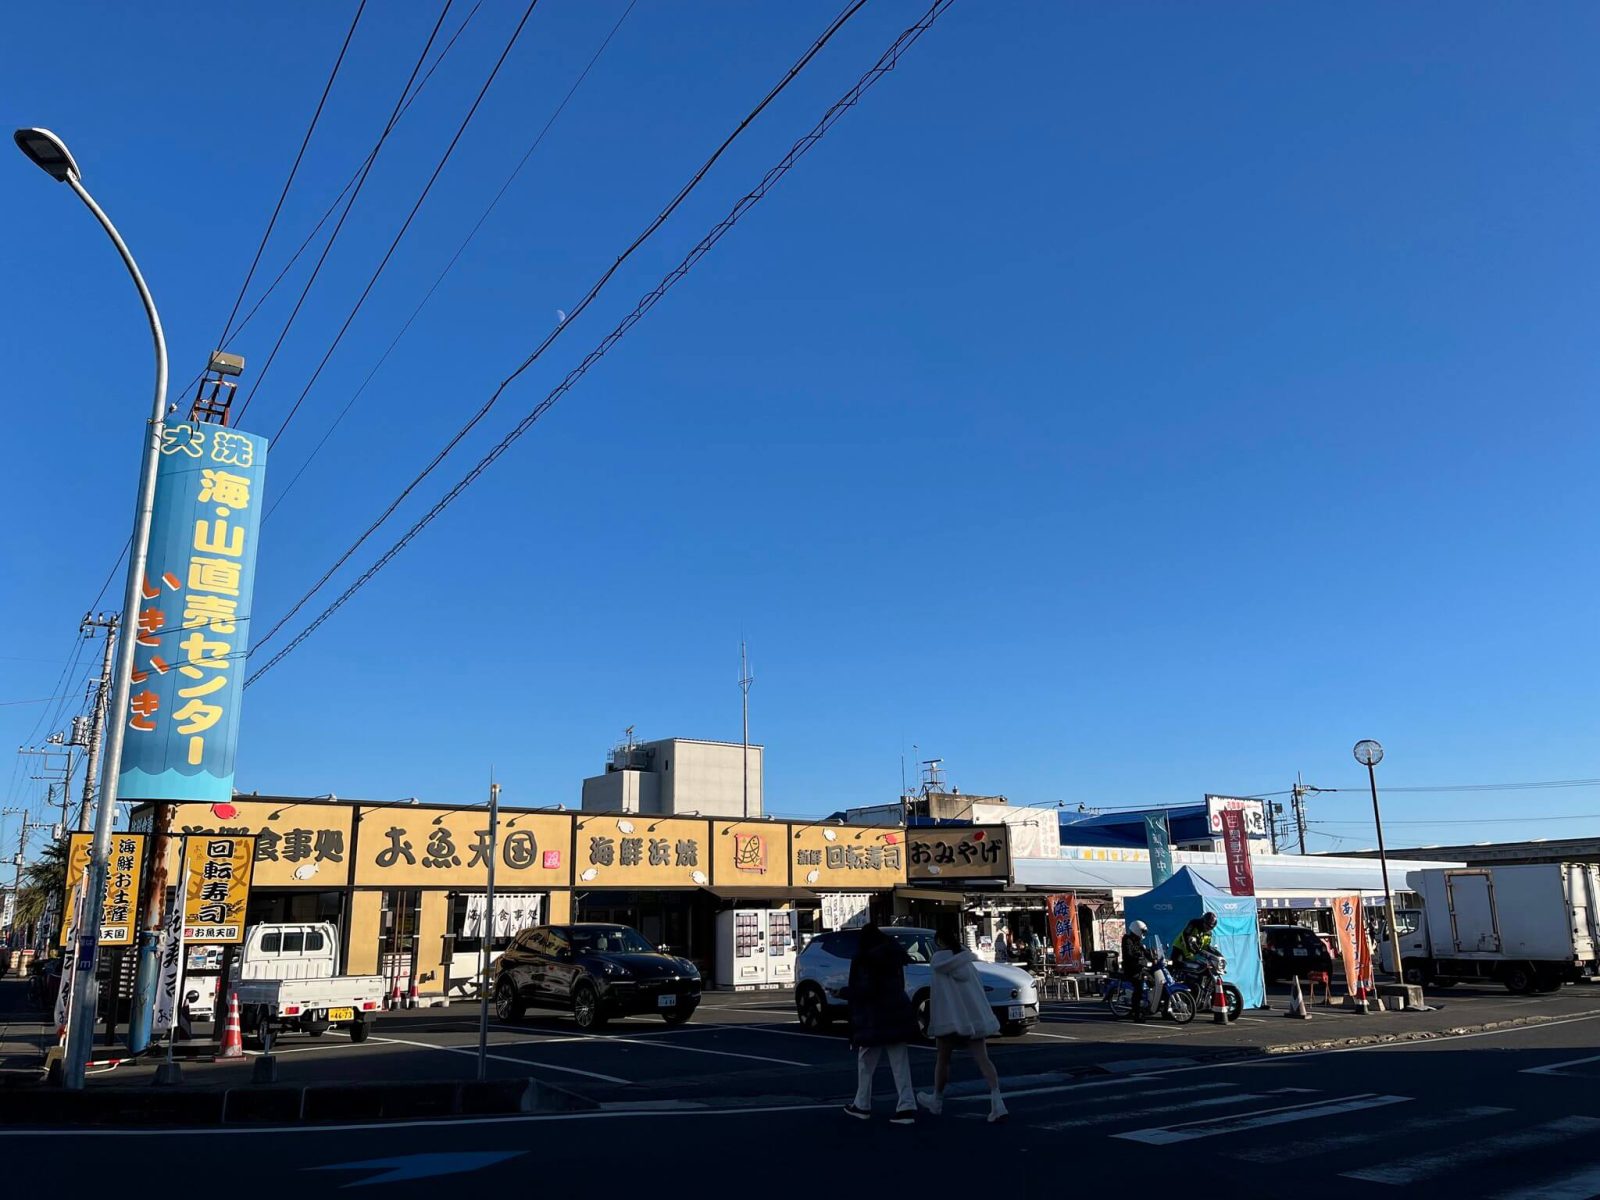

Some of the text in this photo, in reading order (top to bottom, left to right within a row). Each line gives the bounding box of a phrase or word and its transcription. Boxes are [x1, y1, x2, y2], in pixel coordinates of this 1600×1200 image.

[161, 425, 253, 467] 大洗
[172, 469, 251, 765] 海・山直売センター
[129, 571, 181, 731] いきいき
[180, 825, 344, 863] 食事処
[375, 826, 538, 869] お魚天国
[589, 836, 698, 866] 海鮮浜焼
[825, 845, 902, 870] 回転寿司
[911, 839, 1003, 864] おみやげ
[111, 839, 136, 922] 海鮮お土産
[200, 839, 235, 924] 回転寿司
[194, 927, 236, 938] お魚天国
[467, 908, 538, 921] 海食事処
[99, 928, 125, 940] 天国
